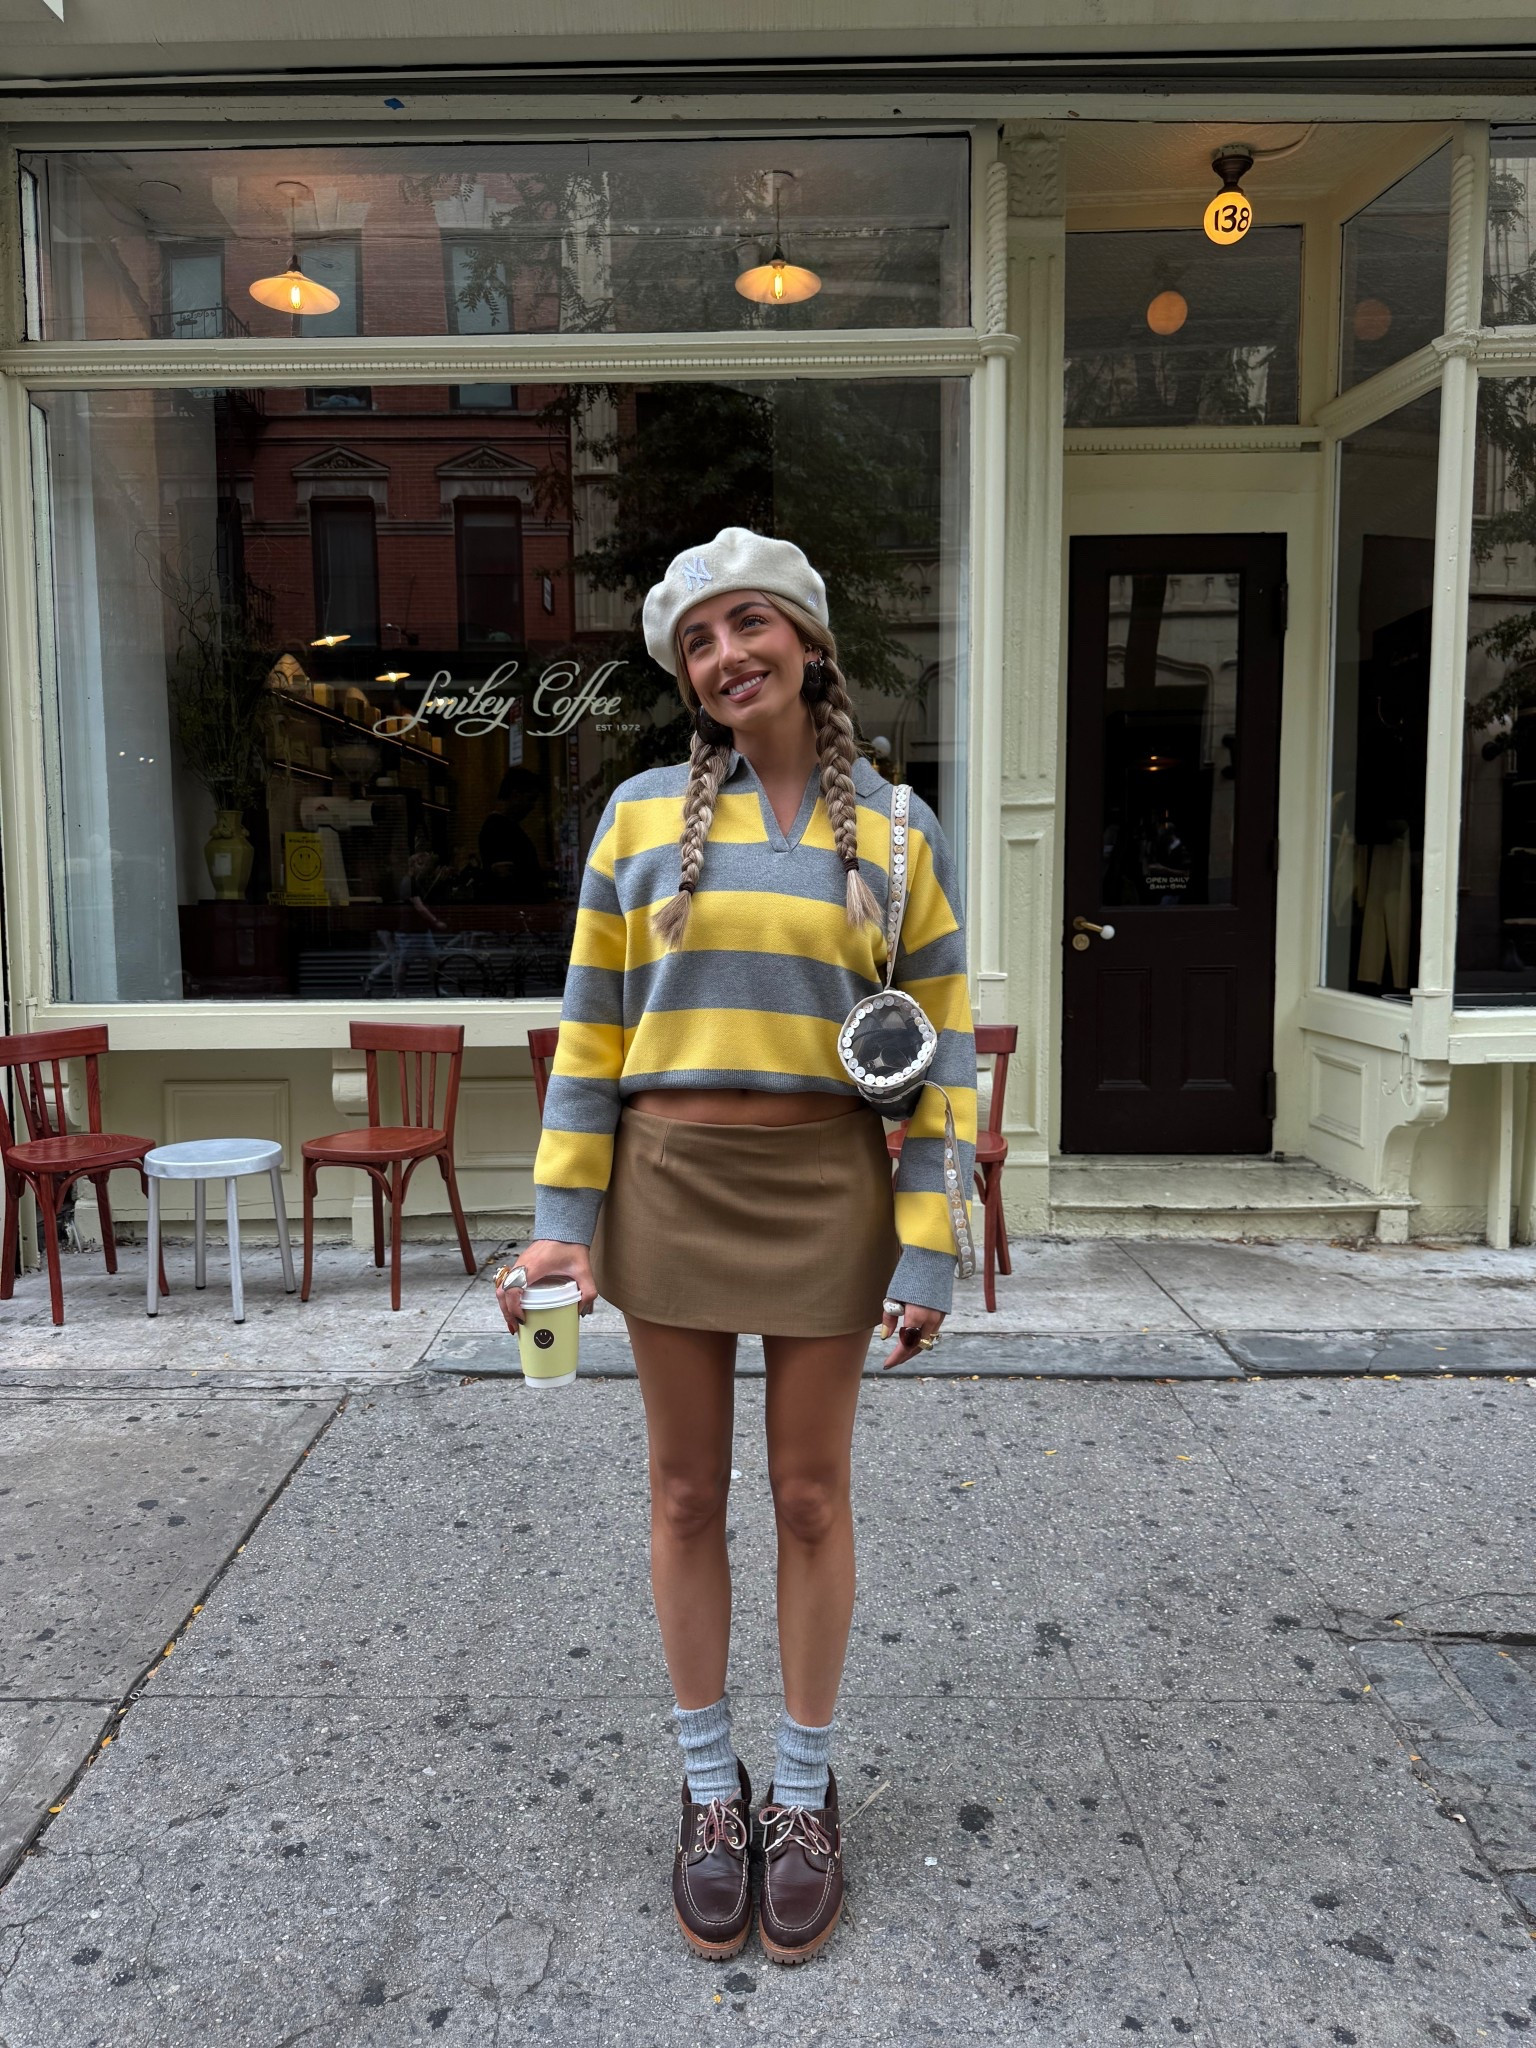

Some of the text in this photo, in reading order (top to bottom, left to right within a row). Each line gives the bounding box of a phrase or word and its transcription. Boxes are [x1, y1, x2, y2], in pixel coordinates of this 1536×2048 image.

[1214, 204, 1250, 233] 138
[682, 556, 713, 591] NY
[373, 660, 519, 737] Smiley
[526, 660, 629, 737] Coffee
[1145, 876, 1168, 884] OPEN
